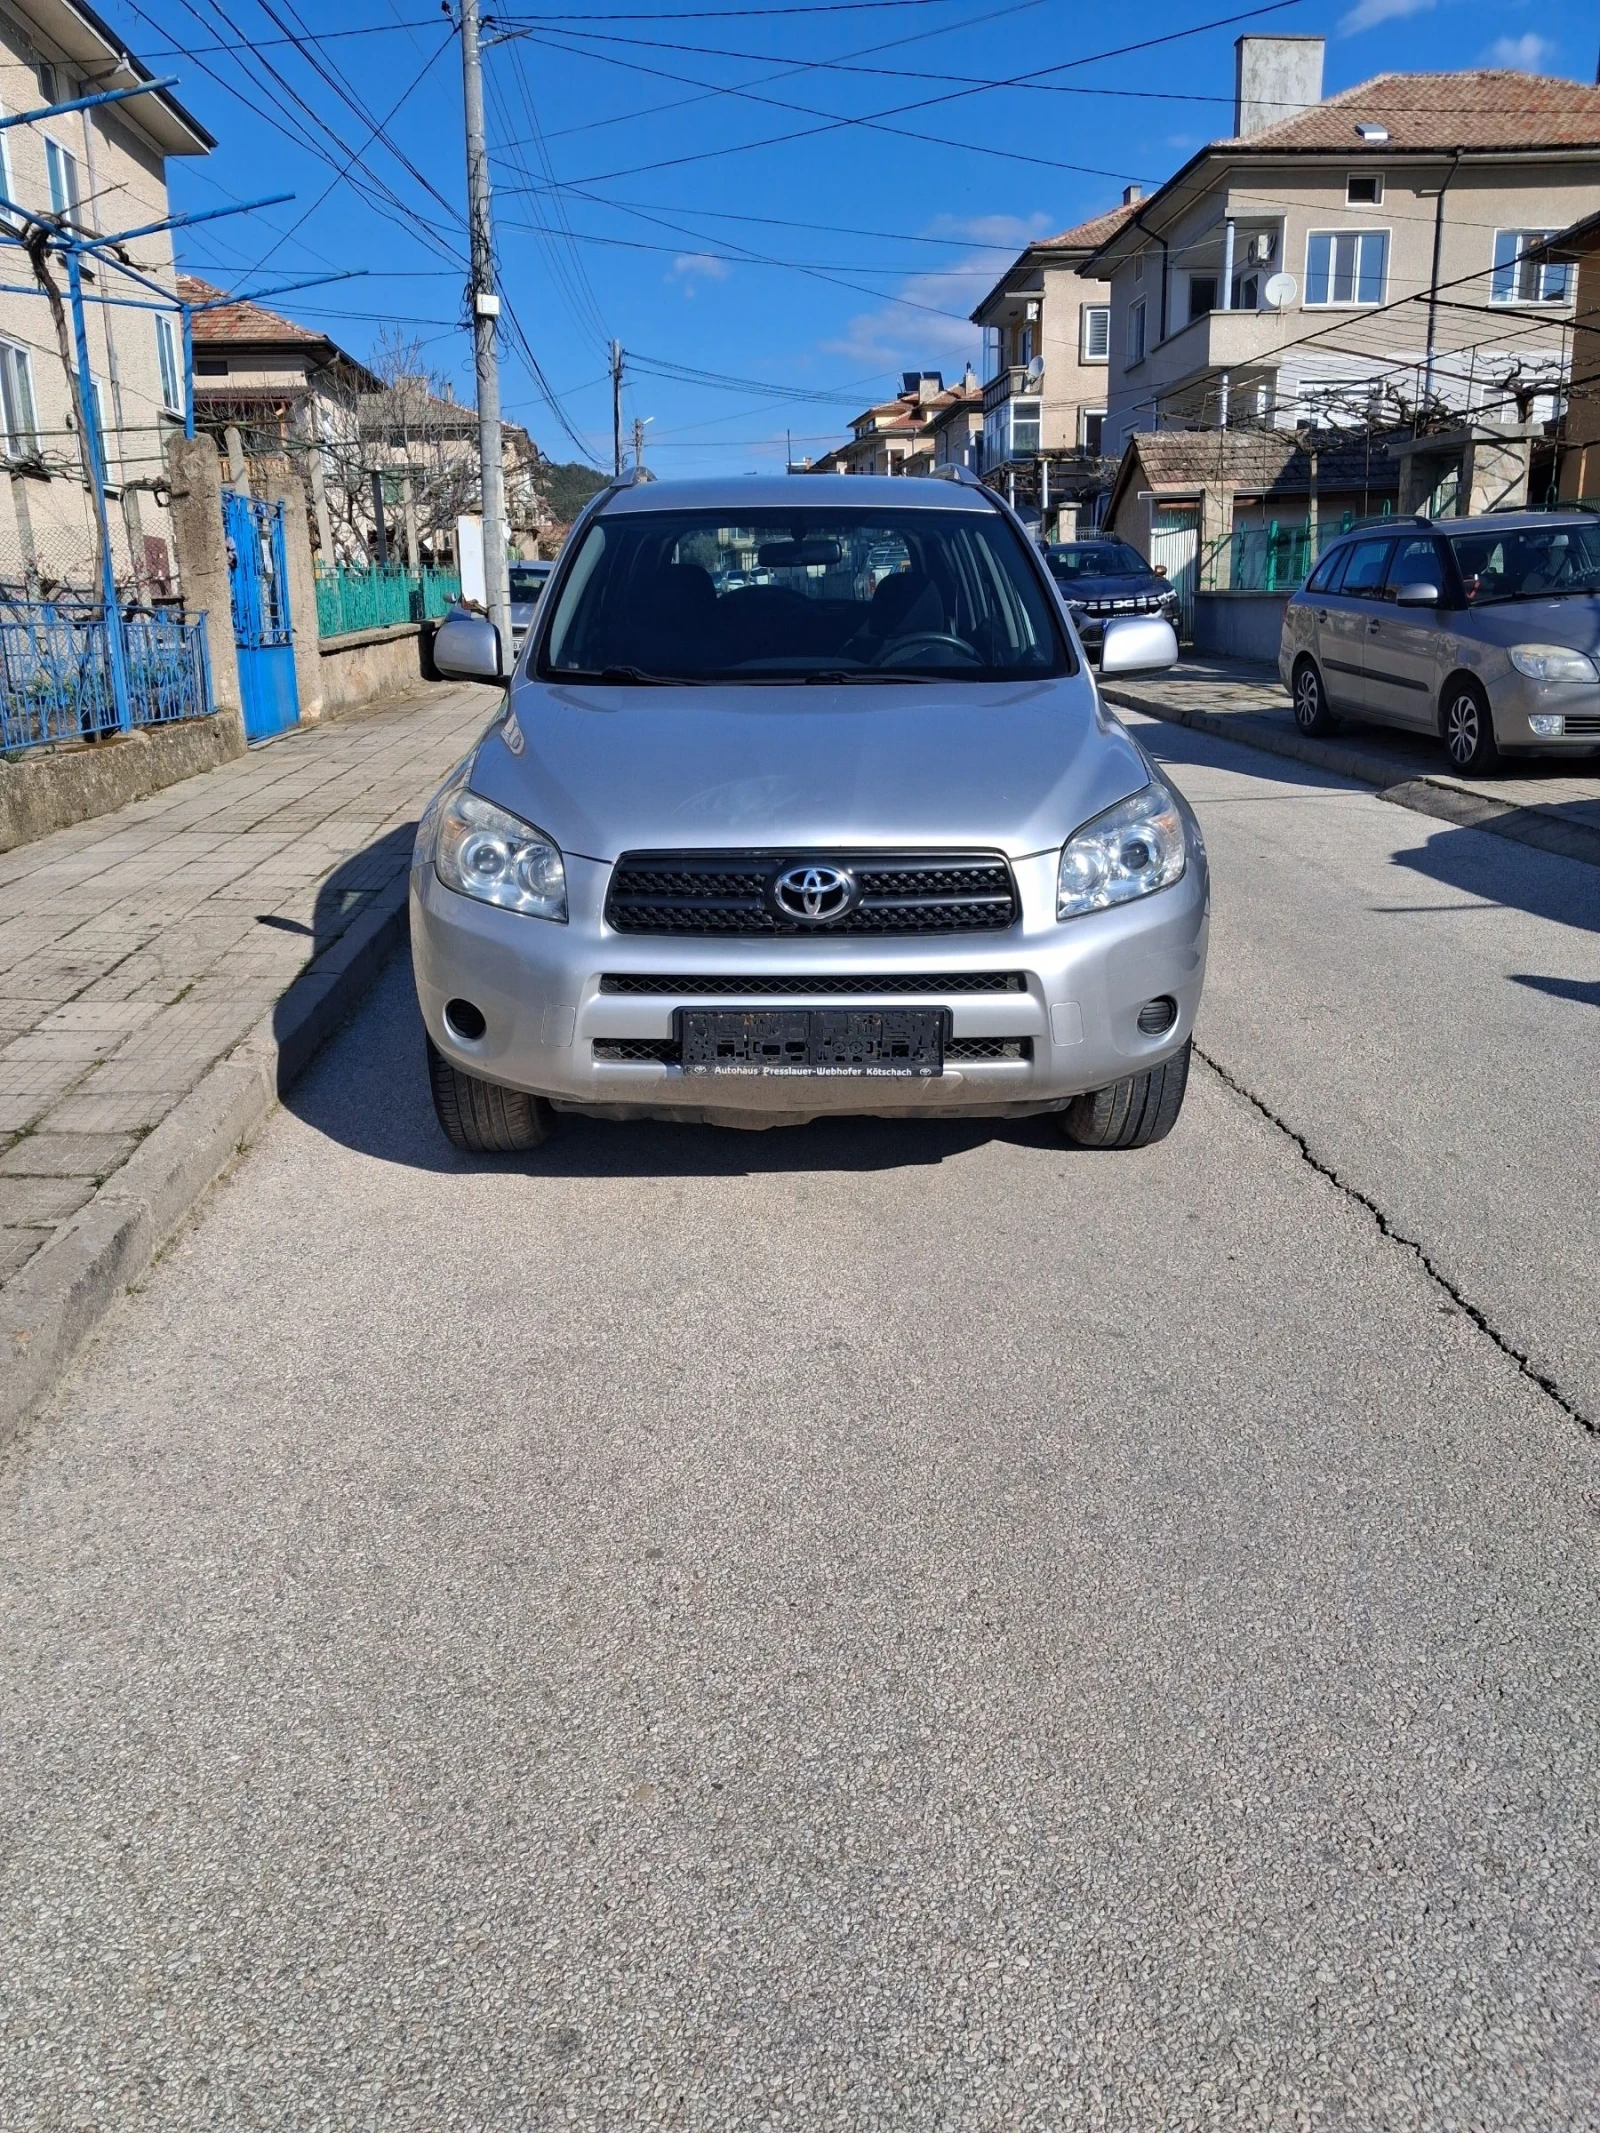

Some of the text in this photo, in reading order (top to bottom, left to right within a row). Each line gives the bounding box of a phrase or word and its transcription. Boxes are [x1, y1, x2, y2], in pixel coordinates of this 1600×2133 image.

[715, 1066, 912, 1076] Autohaus Presslauer-Webhofer Kötschach
